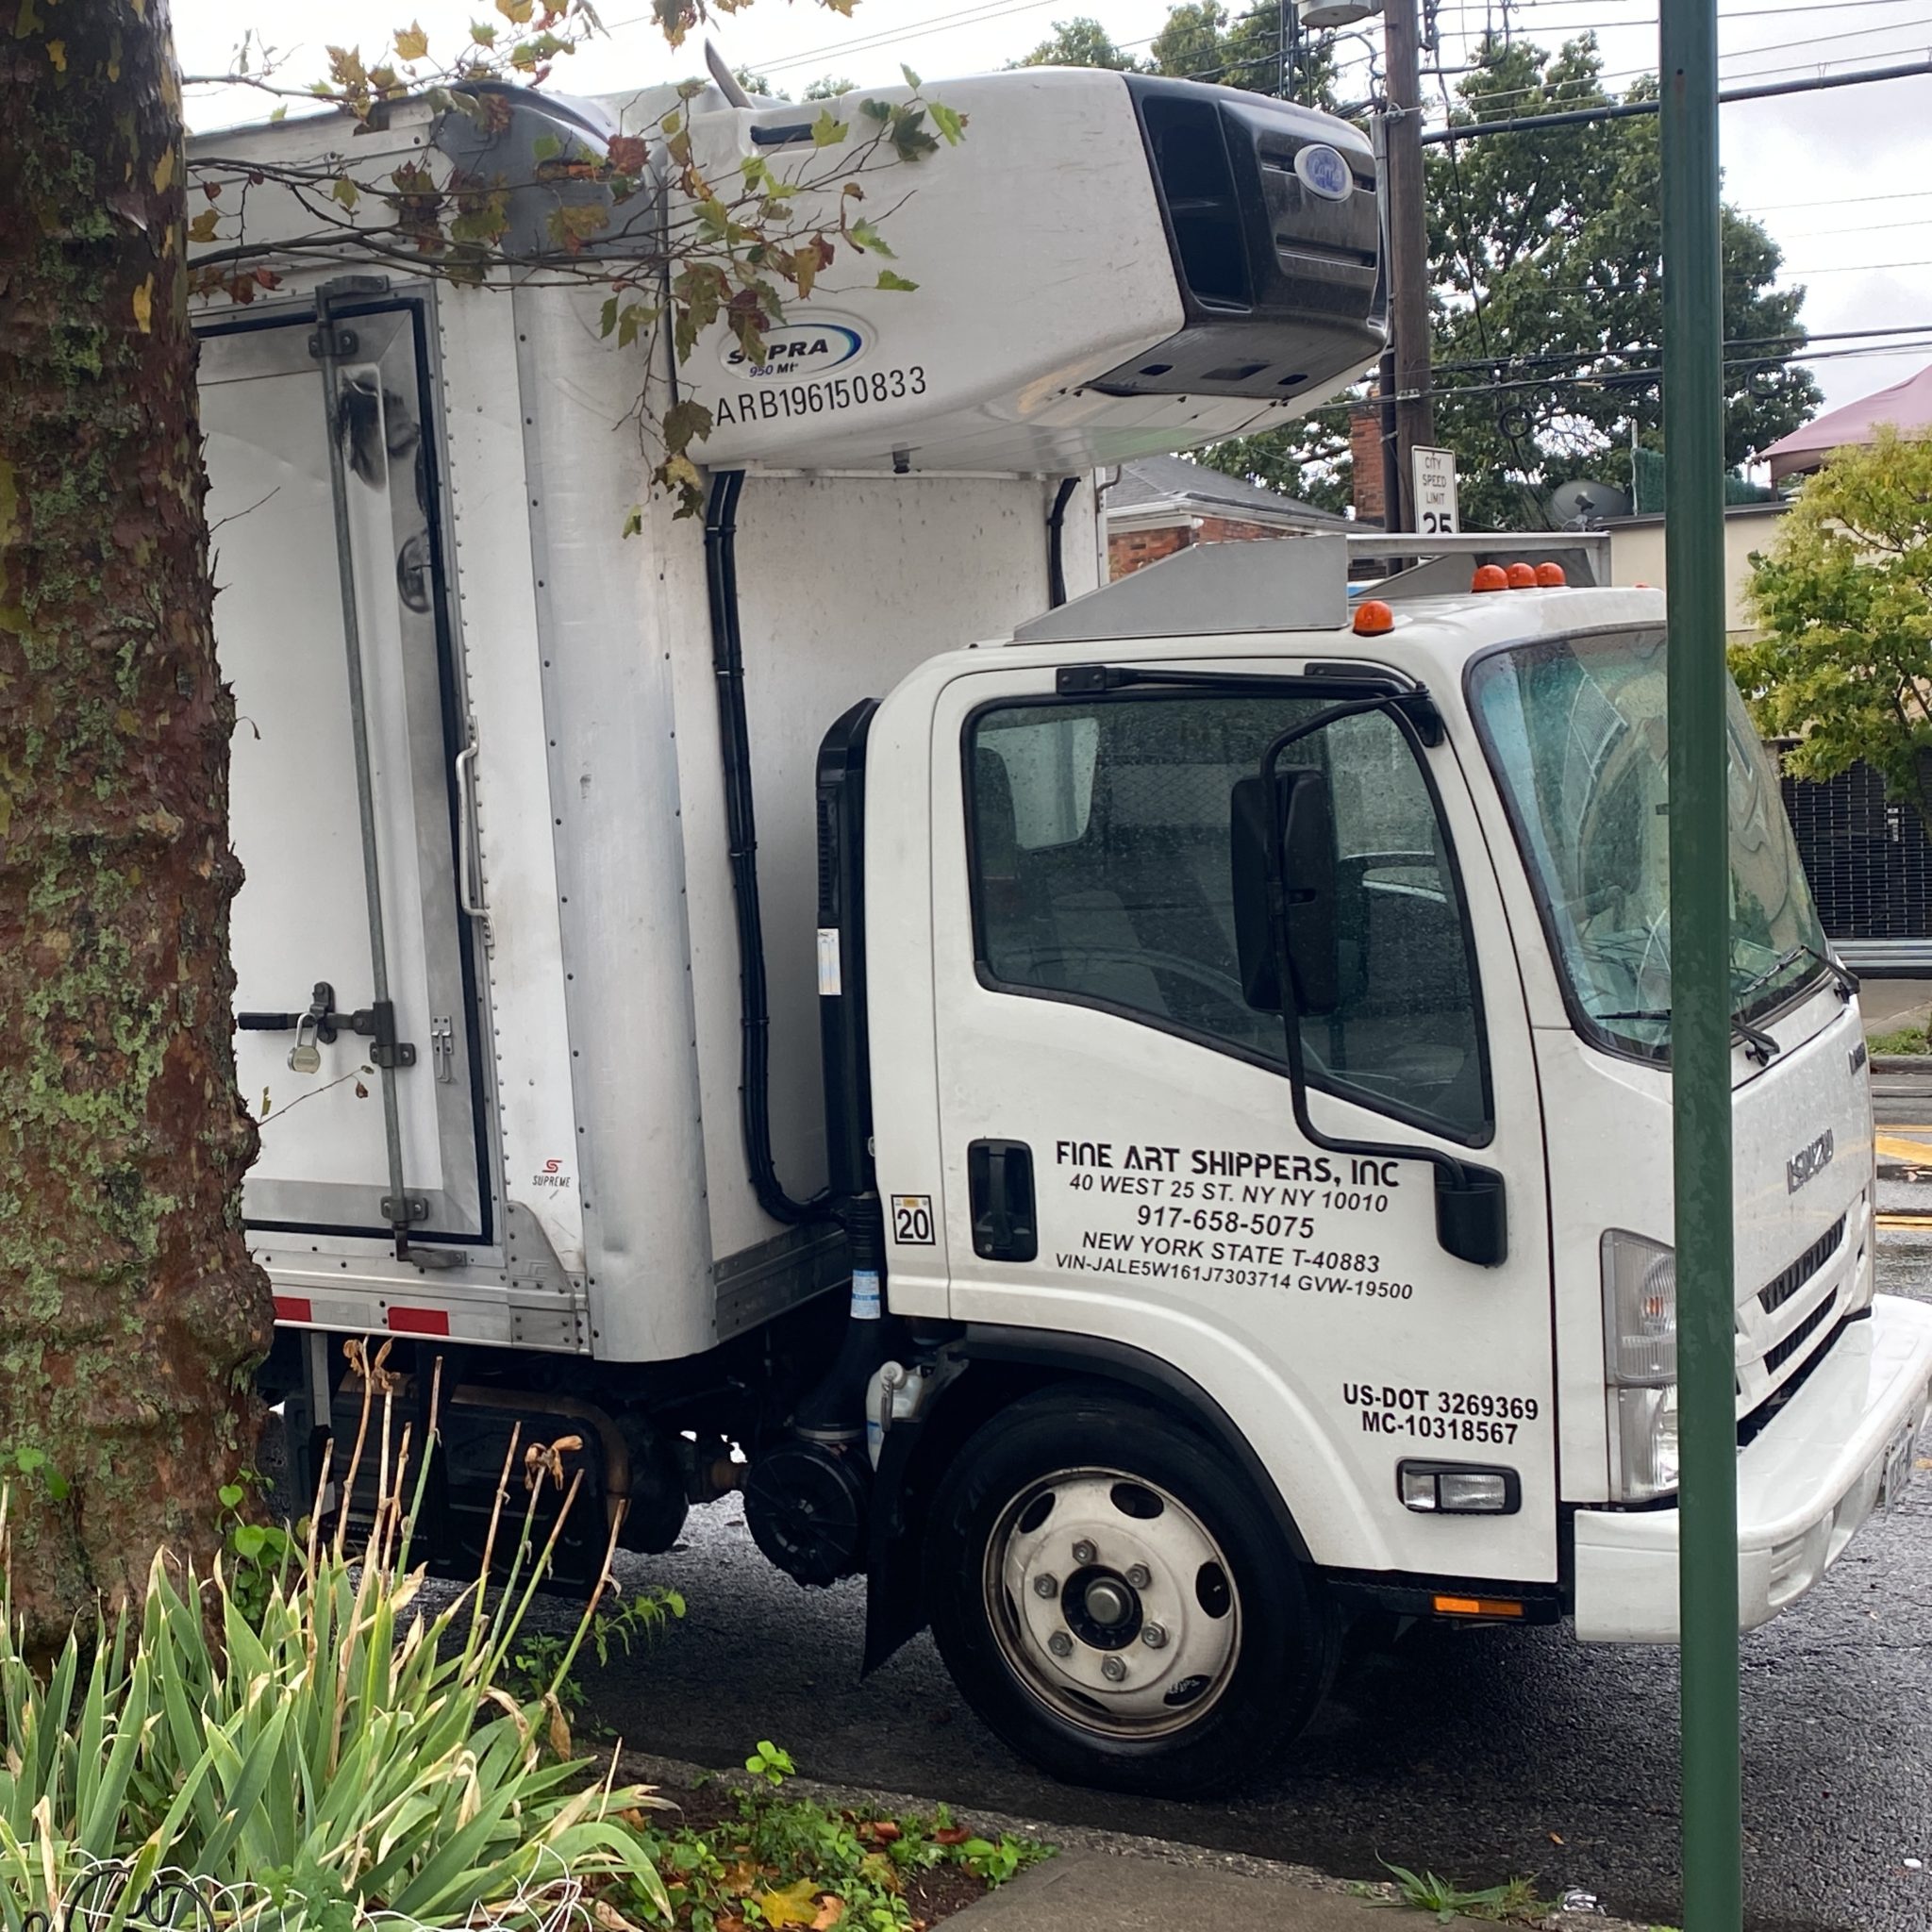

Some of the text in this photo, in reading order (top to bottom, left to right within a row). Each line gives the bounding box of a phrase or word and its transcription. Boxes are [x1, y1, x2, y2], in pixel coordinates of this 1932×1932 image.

[726, 339, 829, 364] SPRA
[716, 366, 926, 426] ARB196150833
[1424, 457, 1441, 470] CITY
[1422, 474, 1447, 488] SPEED
[1425, 492, 1445, 506] LIMIT
[1423, 511, 1453, 533] 25
[1057, 1141, 1400, 1187] FINE ART SHIPPERS, INC
[532, 1175, 571, 1188] SUPREME
[1069, 1174, 1388, 1212] 40 WEST 25 ST. NY NY 10010
[897, 1208, 929, 1240] 20
[1137, 1205, 1315, 1239] 917-658-5075
[1083, 1231, 1380, 1274] NEW YORK STATE T-40883
[1056, 1253, 1413, 1300] VIN-JALE5W161J7303714 GVW-19500
[1343, 1383, 1539, 1420] US-DOT 3269369
[1362, 1410, 1518, 1444] MC-10318567
